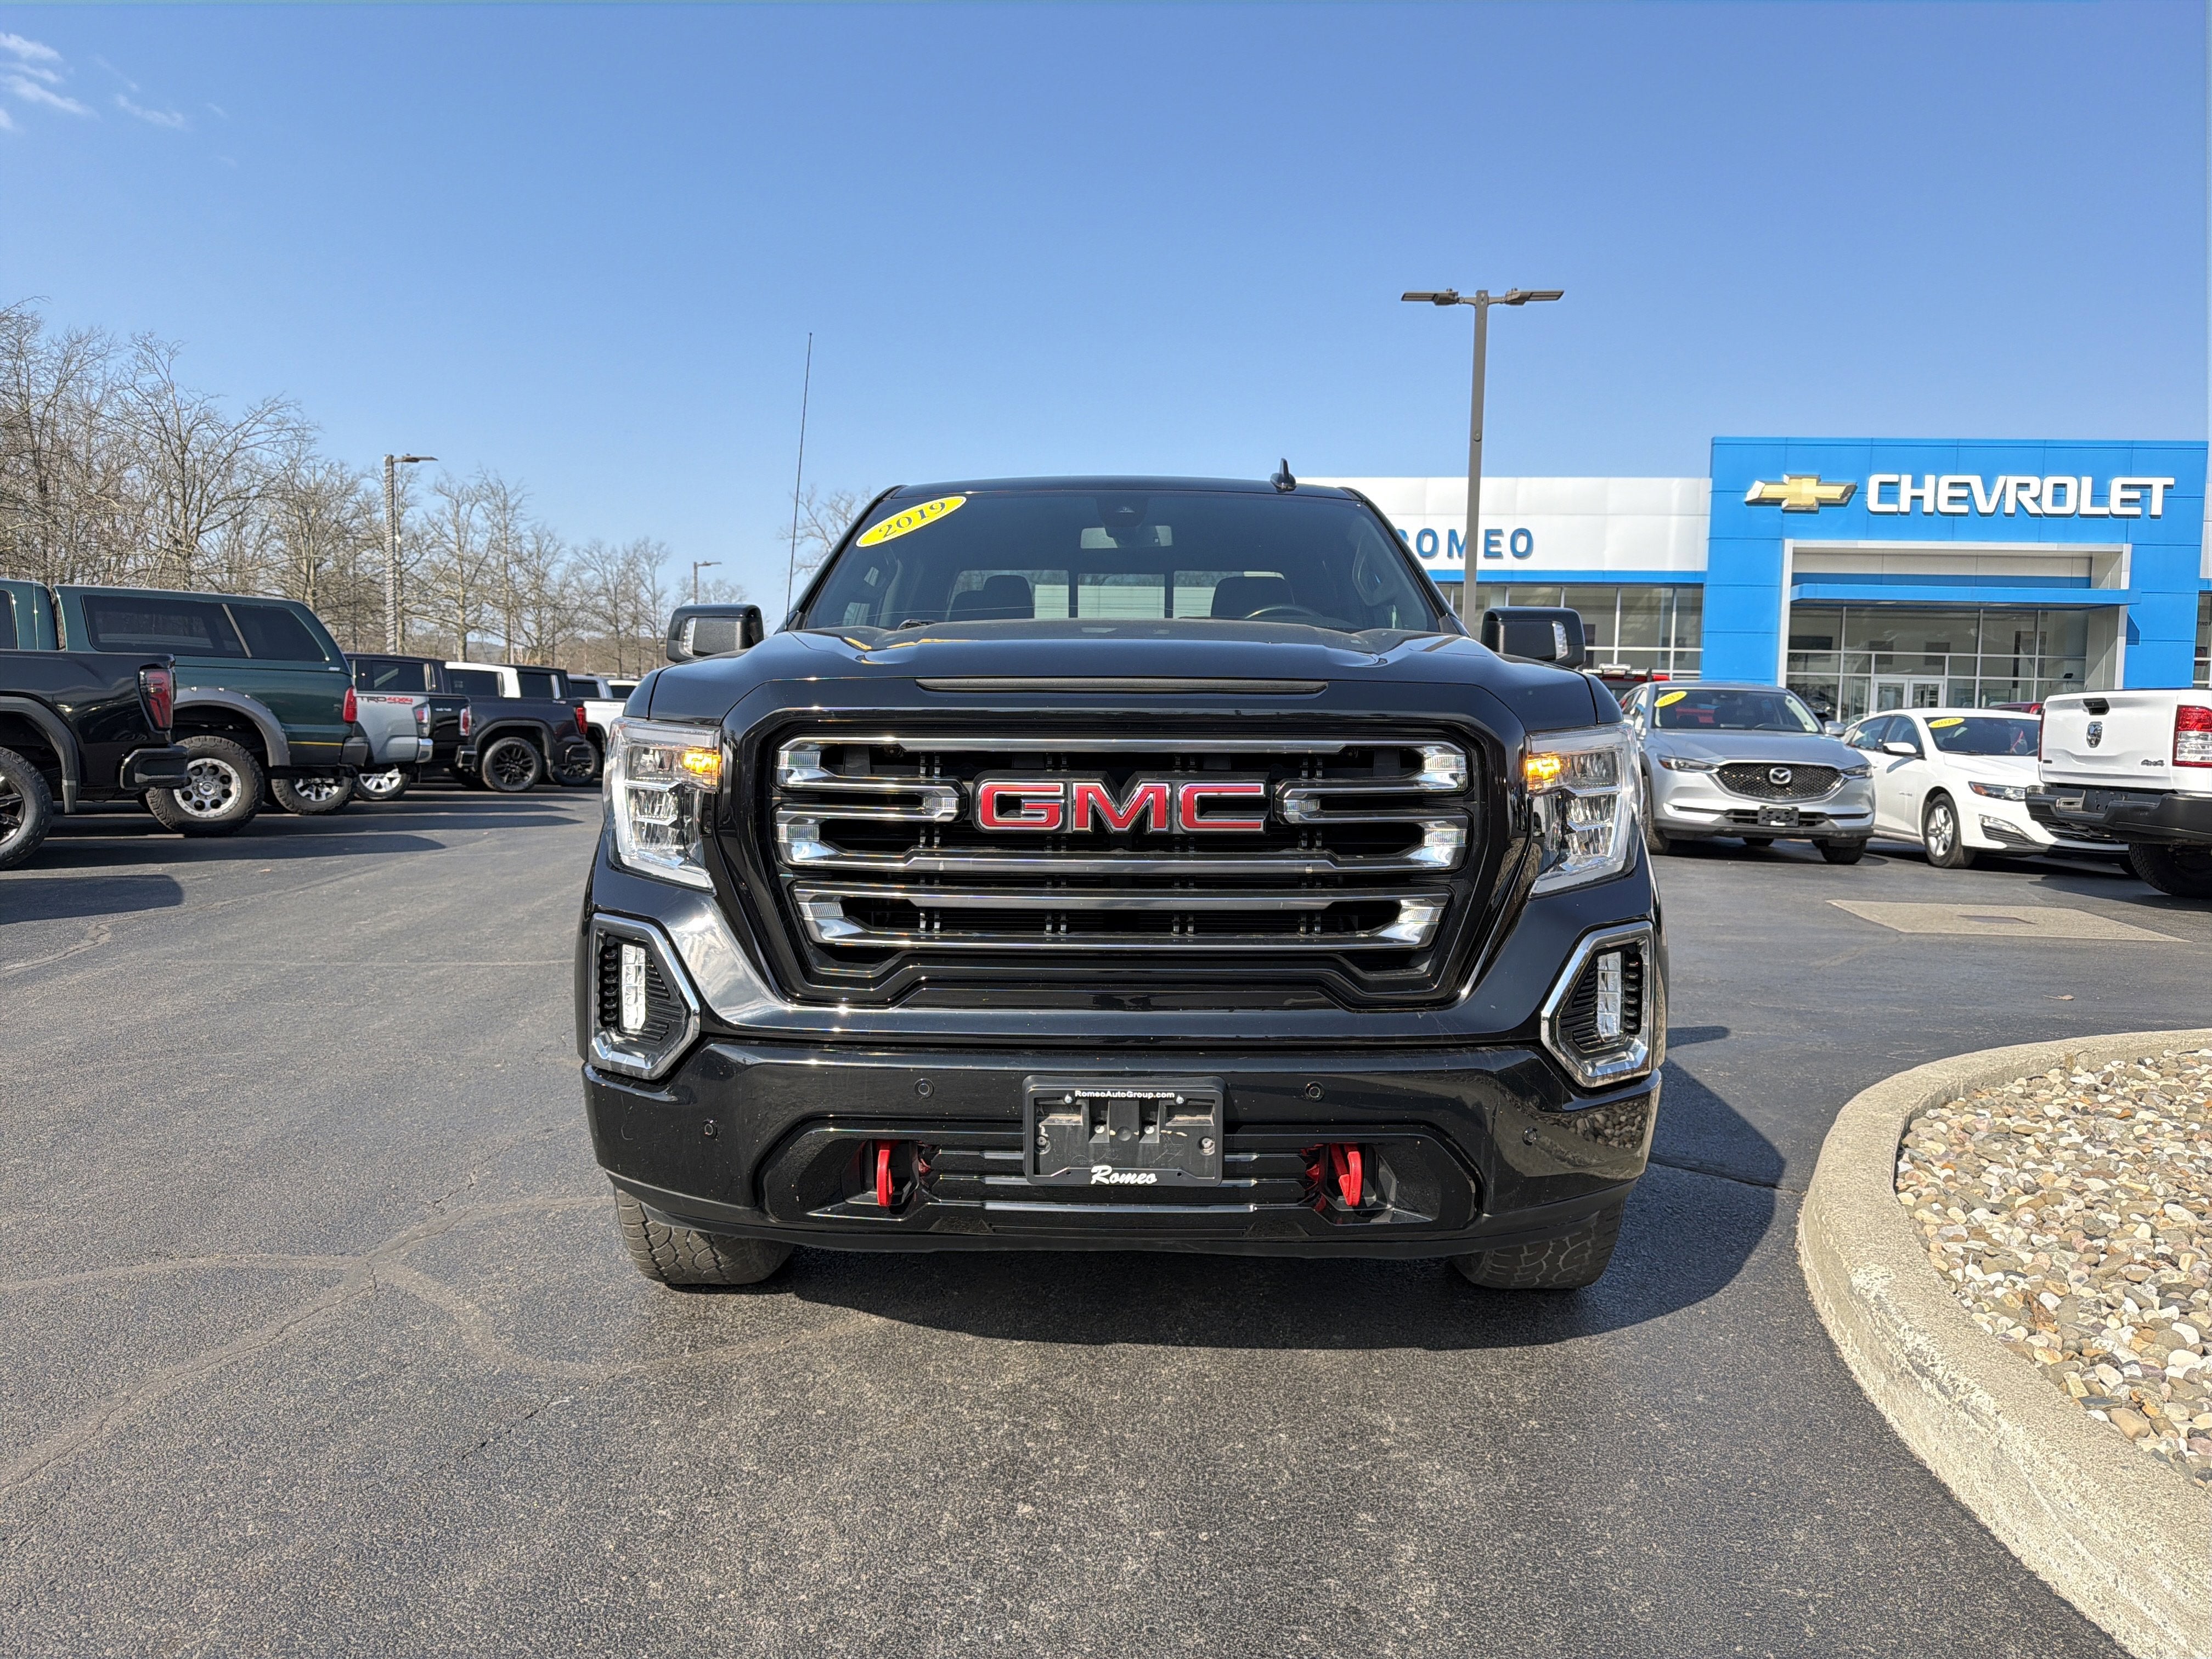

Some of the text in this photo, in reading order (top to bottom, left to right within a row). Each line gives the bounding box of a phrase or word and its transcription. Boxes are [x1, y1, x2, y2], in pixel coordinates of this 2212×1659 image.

[1866, 474, 2175, 517] CHEVROLET
[879, 501, 946, 538] 2019
[977, 780, 1267, 834] GMC
[1074, 1090, 1175, 1099] RomeoAutoGroup.com
[1090, 1165, 1158, 1185] Romeo
